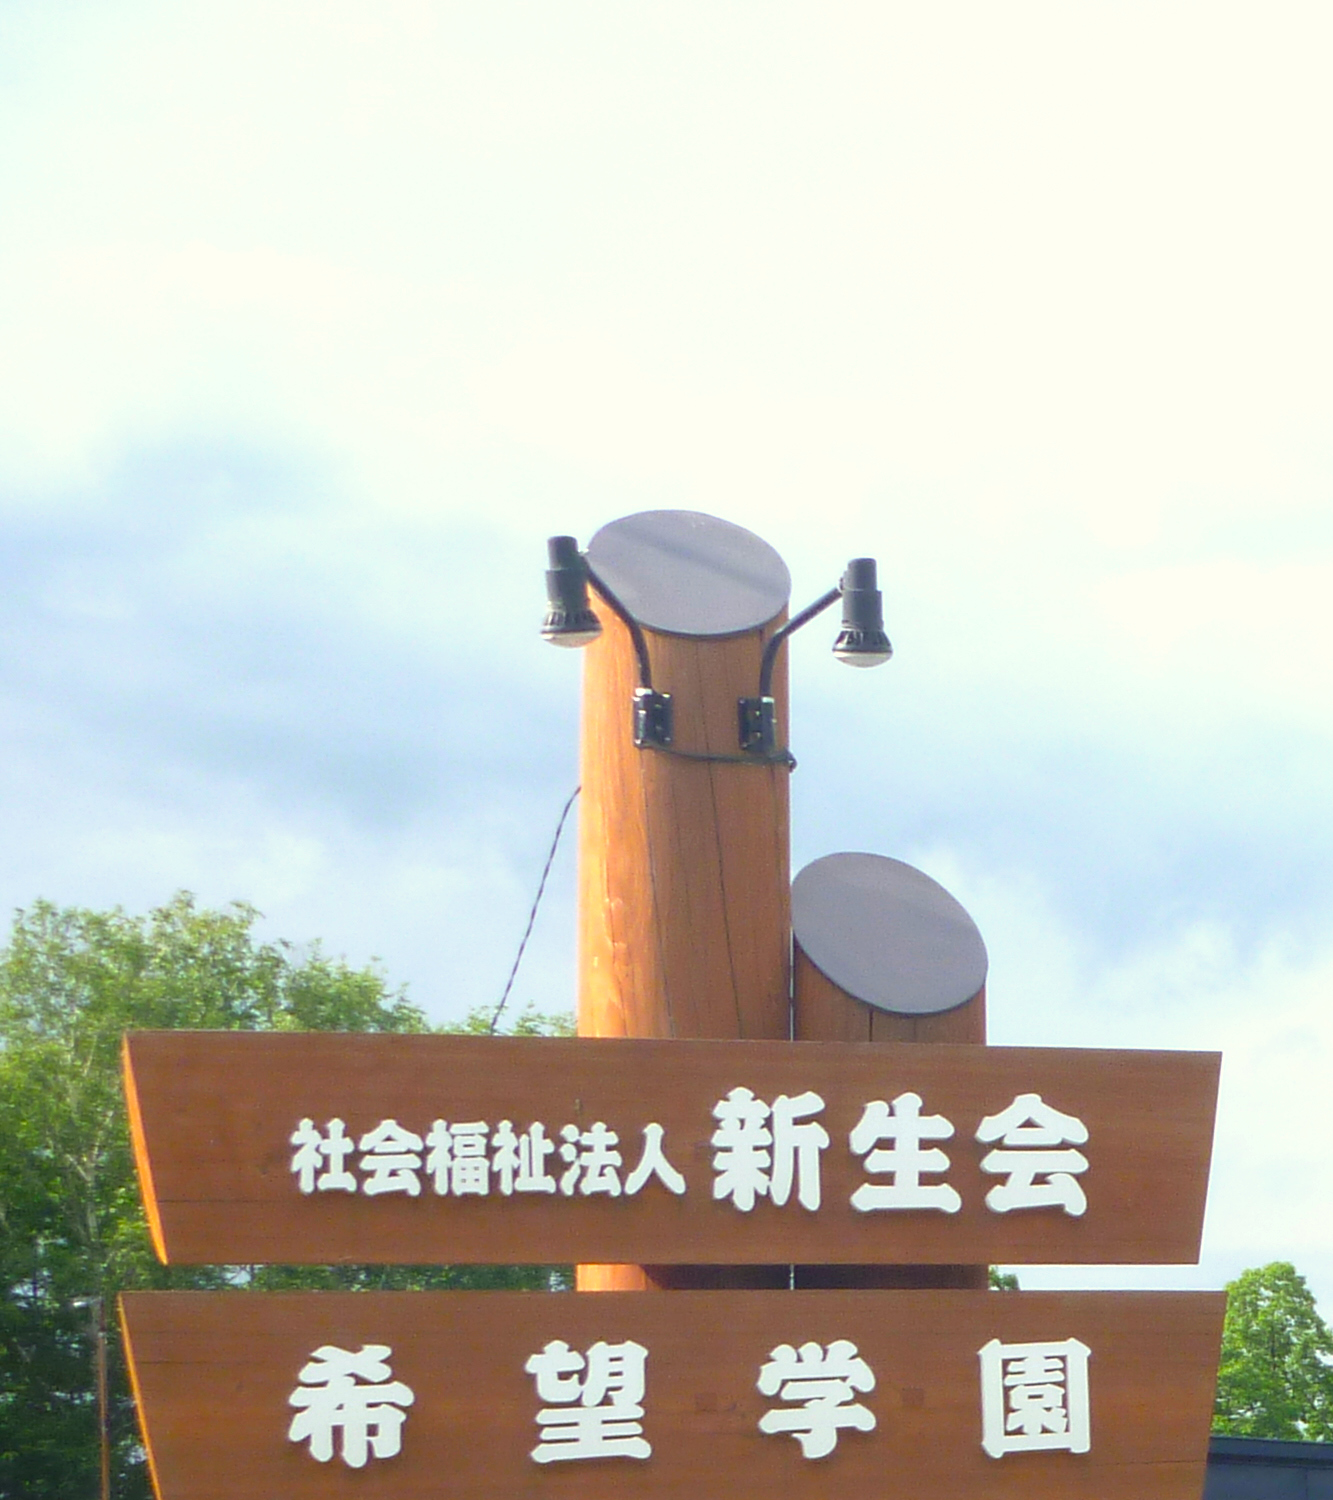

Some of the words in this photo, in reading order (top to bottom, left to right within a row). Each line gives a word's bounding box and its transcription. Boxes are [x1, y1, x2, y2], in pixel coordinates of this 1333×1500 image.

[289, 1117, 687, 1198] 社会福祉法人
[710, 1086, 1091, 1217] 新生会
[287, 1337, 1093, 1469] 希望学園
